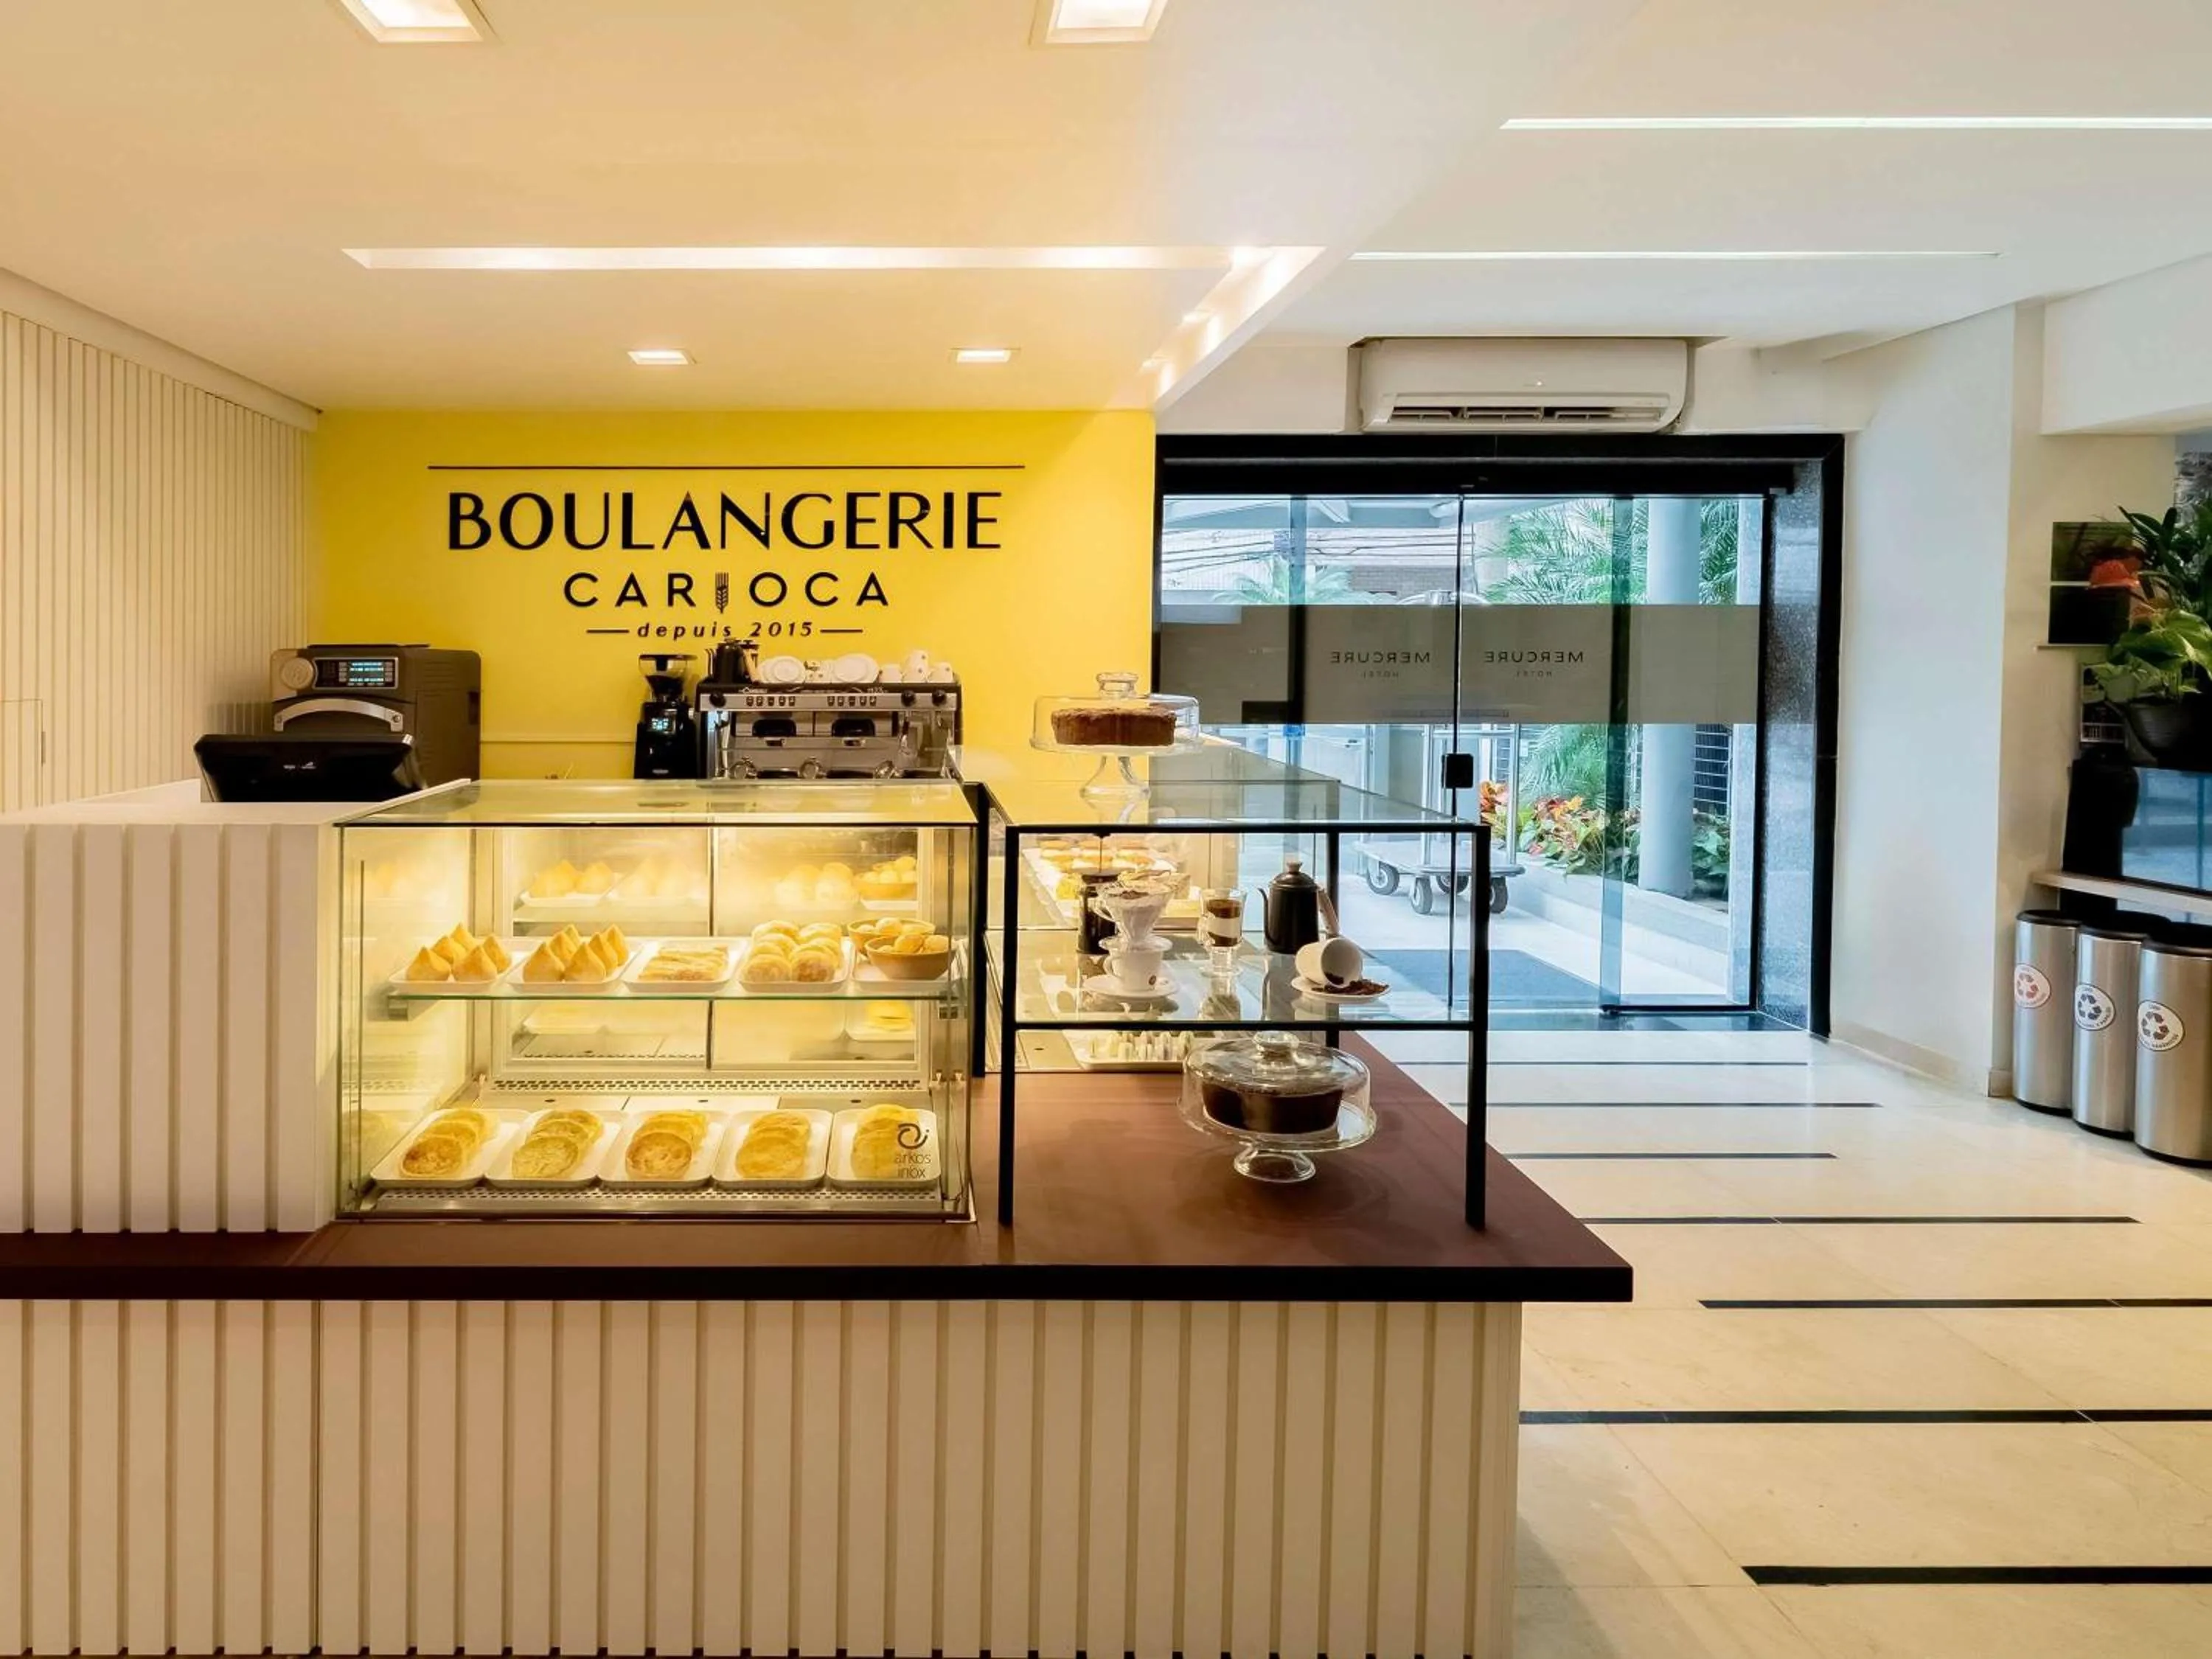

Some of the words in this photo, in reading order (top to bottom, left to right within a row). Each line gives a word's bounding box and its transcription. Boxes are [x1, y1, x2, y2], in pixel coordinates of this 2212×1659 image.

[448, 491, 1002, 551] BOULANGERIE
[637, 622, 731, 640] depuis
[750, 622, 813, 638] 2015
[894, 1152, 931, 1164] arkos
[897, 1165, 926, 1179] inox
